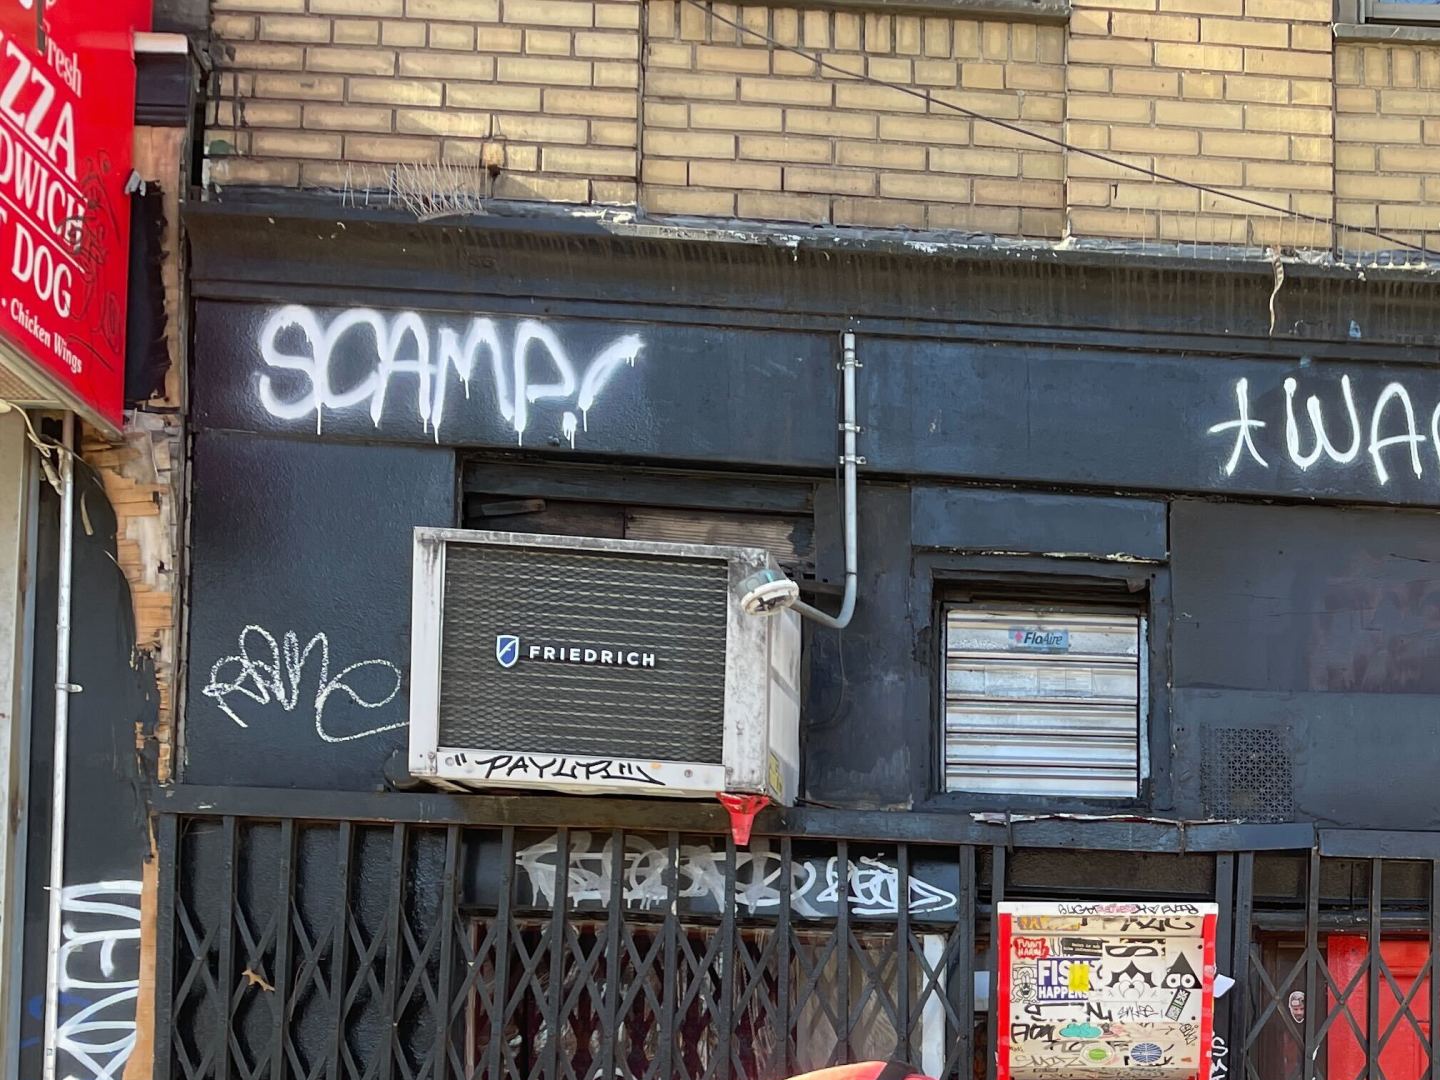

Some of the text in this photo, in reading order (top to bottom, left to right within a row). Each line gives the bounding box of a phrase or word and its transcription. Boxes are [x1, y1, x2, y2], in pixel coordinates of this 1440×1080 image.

[12, 222, 72, 319] DOG
[11, 298, 83, 374] Chicken Wings
[529, 645, 655, 667] FRIEDRICH
